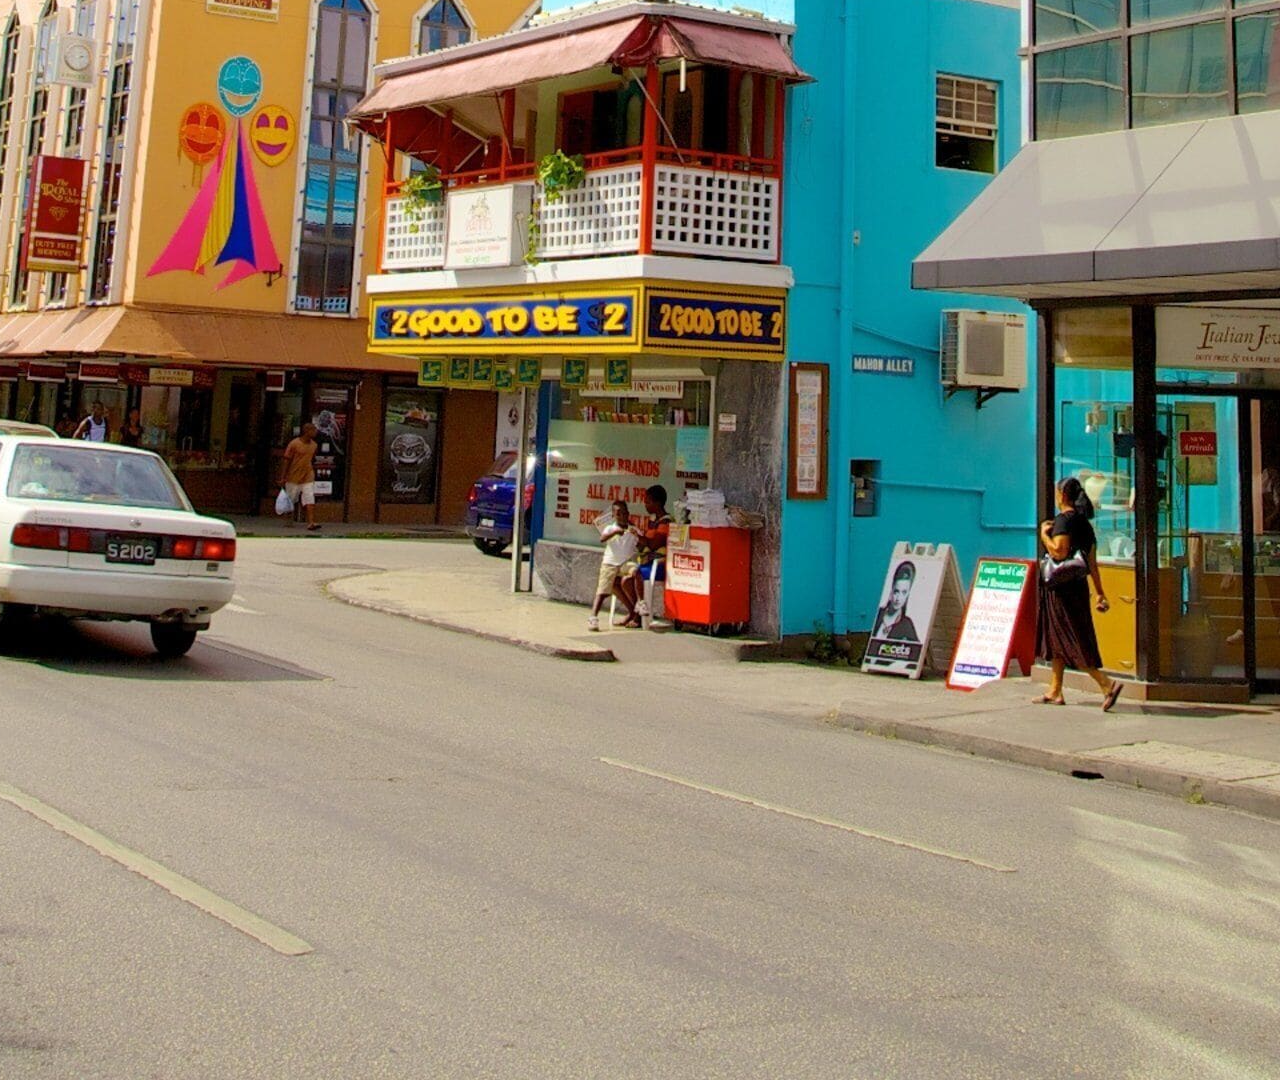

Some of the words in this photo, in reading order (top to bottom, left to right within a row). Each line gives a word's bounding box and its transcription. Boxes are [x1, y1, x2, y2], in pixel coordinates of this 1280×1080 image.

[41, 183, 80, 201] ROYAL
[57, 241, 75, 250] FREE
[486, 306, 528, 333] TO
[533, 305, 579, 332] BE
[715, 308, 739, 335] TO
[739, 310, 764, 337] BE
[1196, 322, 1254, 350] Italian
[853, 357, 884, 371] MAHON
[886, 359, 914, 373] ALLEY
[1231, 353, 1240, 363] &
[1183, 444, 1214, 452] Arrivals
[594, 457, 616, 472] TOP
[617, 457, 661, 478] BRANDS
[586, 483, 606, 500] ALL
[607, 485, 621, 502] AT
[623, 488, 631, 503] A
